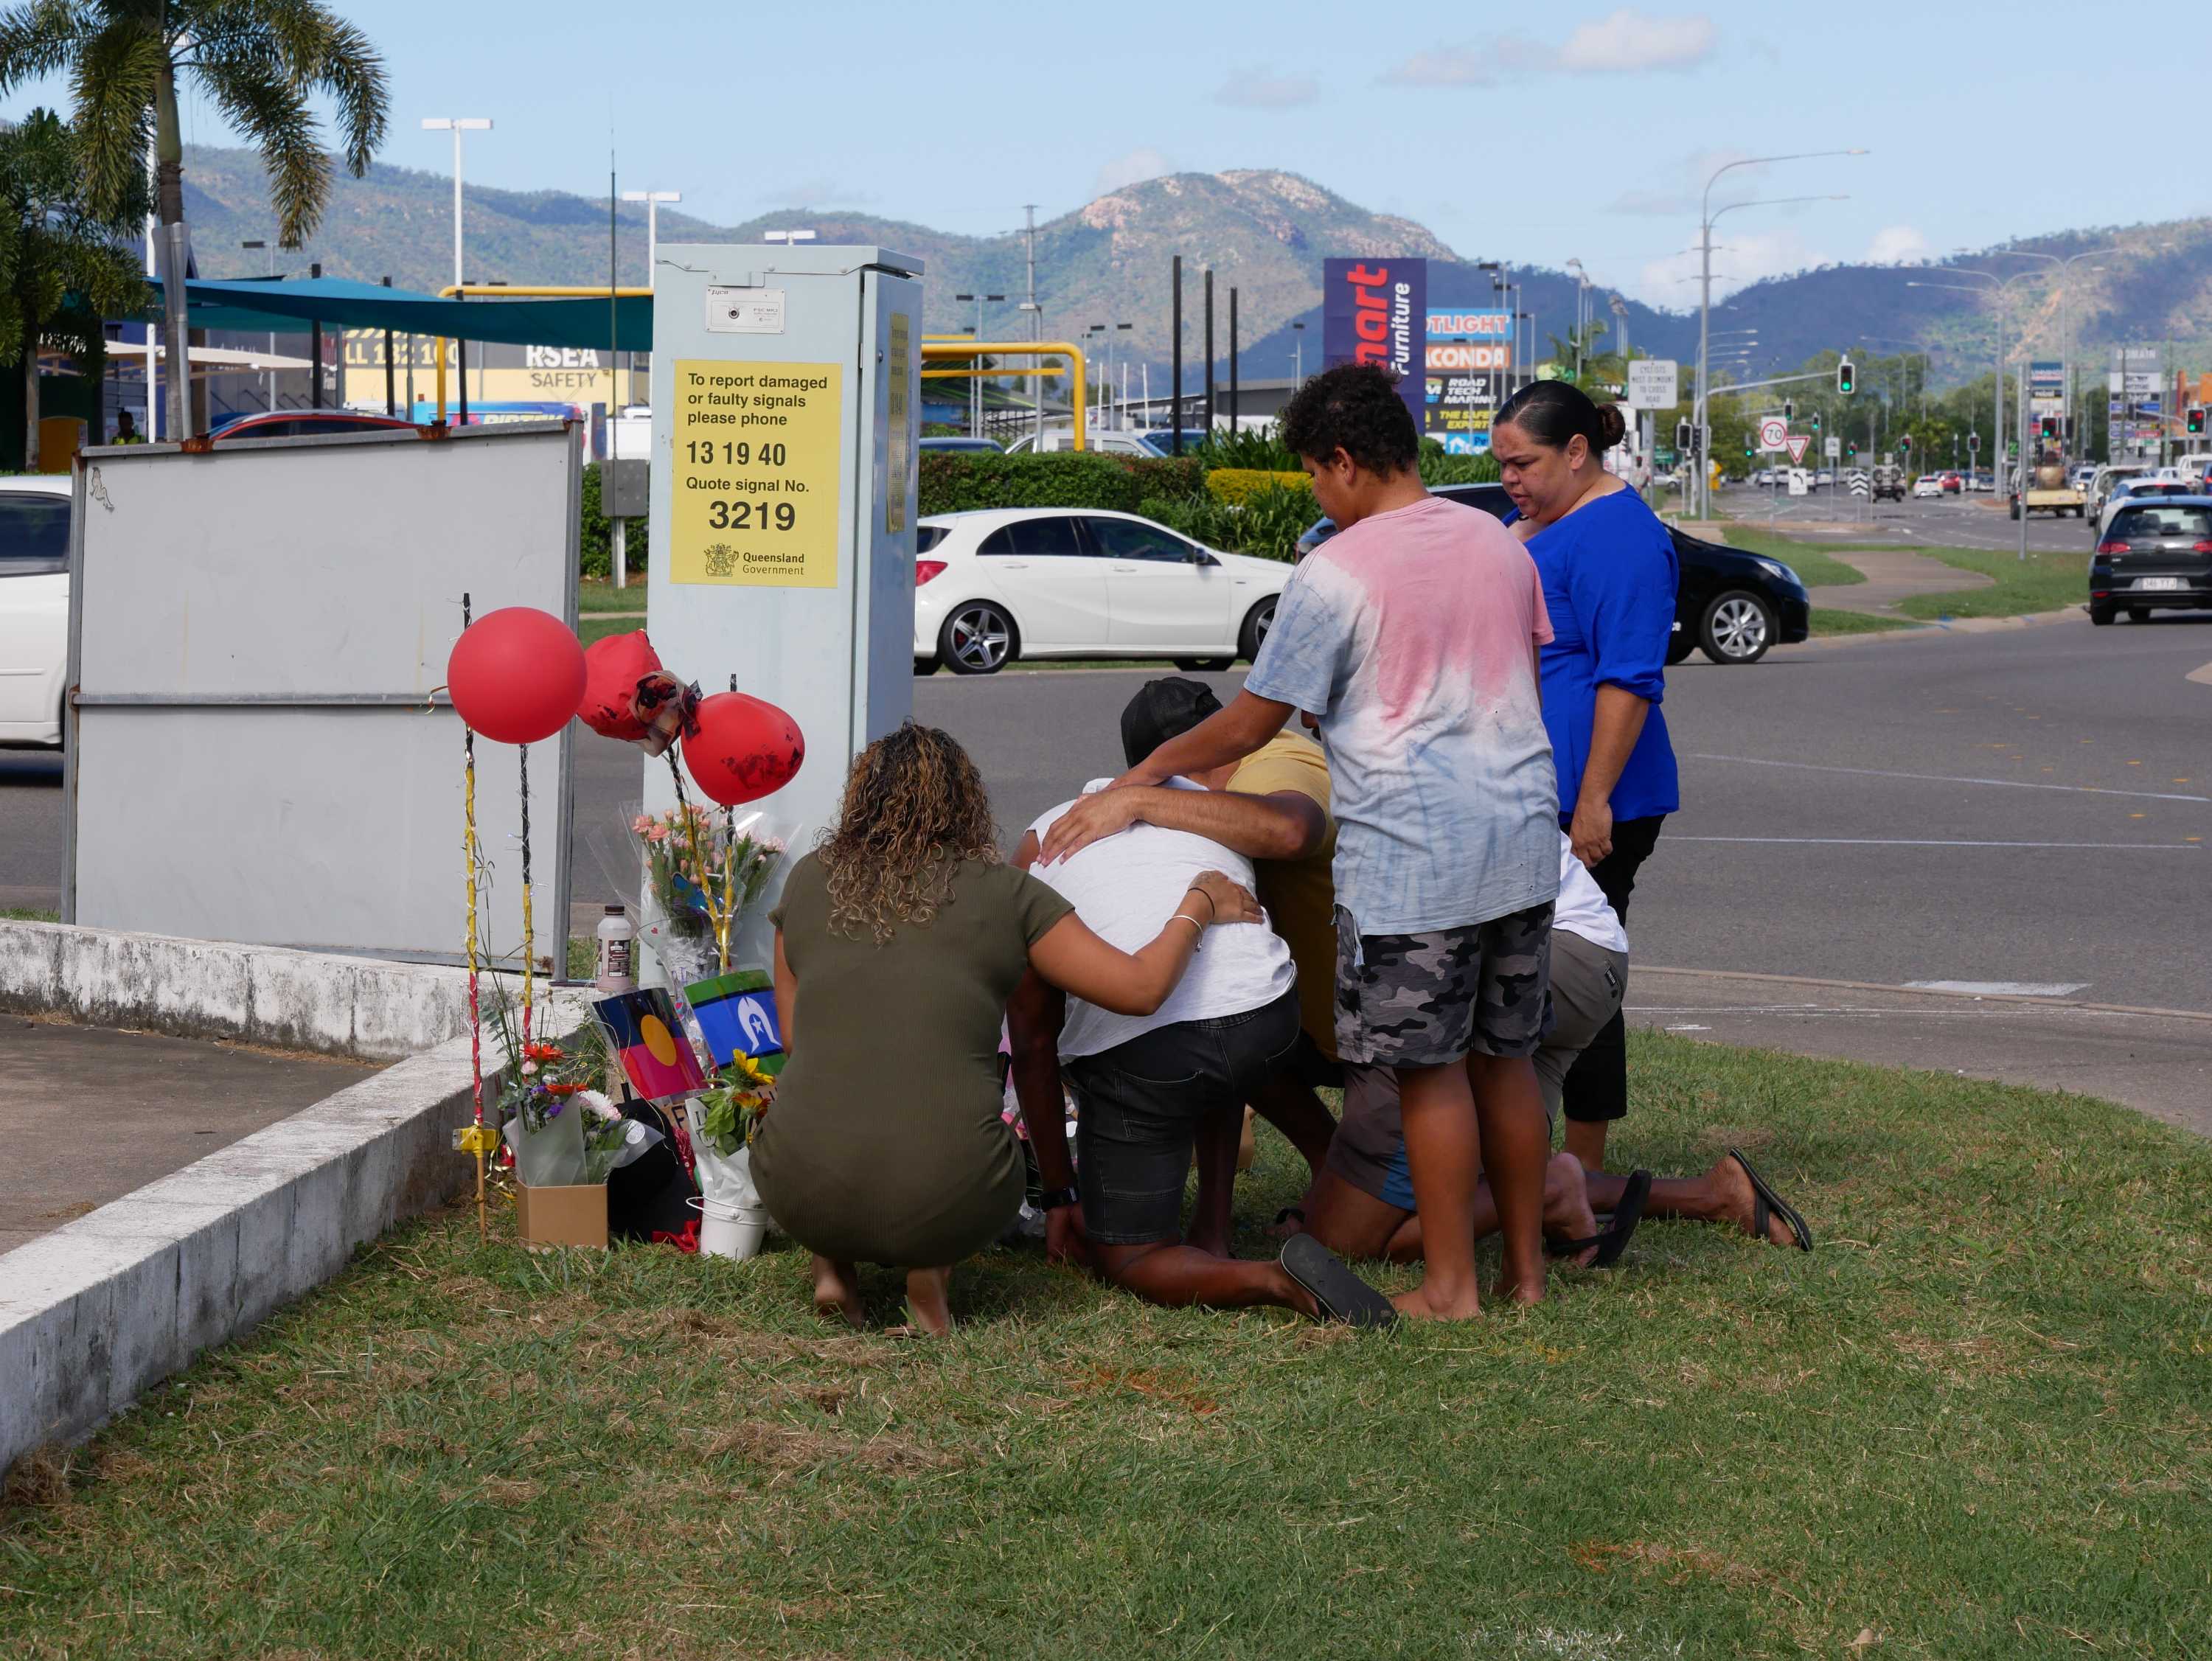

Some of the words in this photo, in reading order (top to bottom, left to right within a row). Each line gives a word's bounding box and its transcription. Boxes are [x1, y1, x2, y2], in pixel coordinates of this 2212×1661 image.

[420, 343, 458, 365] 10
[531, 372, 597, 388] SAFETY
[688, 373, 705, 386] To
[709, 375, 754, 389] report
[759, 375, 827, 391] damaged
[1448, 378, 1486, 387] ROAD
[688, 394, 703, 404] or
[708, 392, 748, 408] faulty
[753, 394, 806, 409] signals
[688, 411, 736, 425] please
[741, 412, 787, 428] phone
[1767, 430, 1782, 439] 70
[686, 441, 714, 464] 13
[723, 442, 750, 465] 19
[758, 442, 786, 467] 40
[686, 477, 731, 490] Quote
[735, 479, 779, 493] signal
[785, 480, 810, 492] No.
[709, 501, 796, 531] 3219
[743, 552, 804, 563] Queensland
[742, 565, 804, 575] Government
